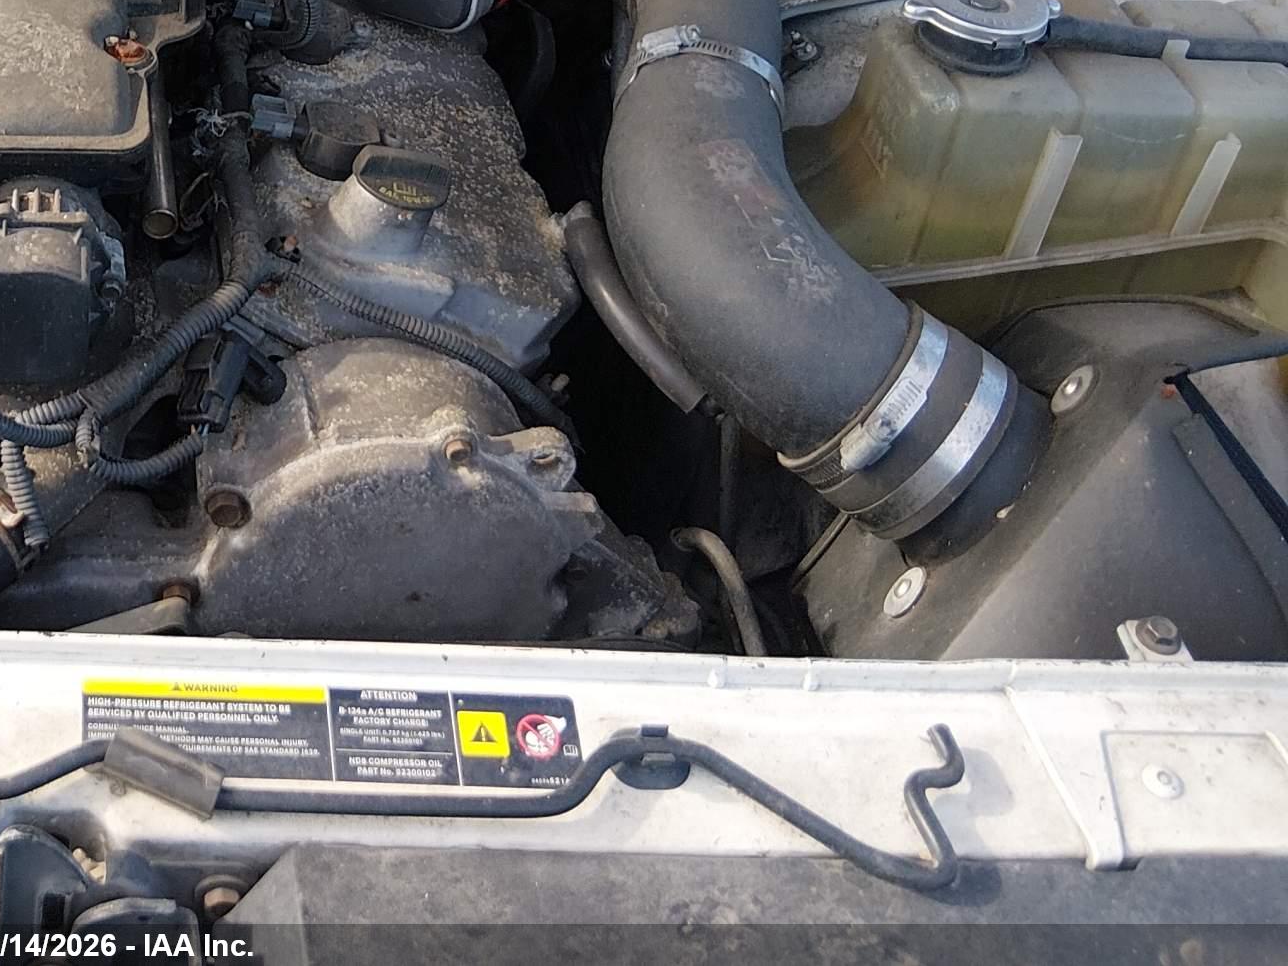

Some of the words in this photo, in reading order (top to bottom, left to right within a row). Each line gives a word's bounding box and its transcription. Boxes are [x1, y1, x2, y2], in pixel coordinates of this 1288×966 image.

[184, 683, 239, 694] WARNING
[360, 689, 418, 701] ATTENTION
[87, 696, 161, 709] HIGH-PRESSURE
[163, 700, 225, 712] REFRIGERANT
[227, 703, 263, 713] SYSTEM
[264, 704, 277, 713] TO
[278, 704, 291, 714] BE
[87, 708, 133, 718] SERVICED
[134, 709, 147, 718] BY
[148, 710, 195, 721] QUALIFIED
[197, 712, 252, 722] PERSONNEL
[253, 713, 280, 724] ONLY.
[367, 707, 385, 716] A/C
[386, 708, 442, 718] REFRIGERANT
[353, 717, 391, 726] FACTORY
[155, 726, 190, 734] MANUAL.
[159, 734, 196, 743] METHODS
[197, 736, 214, 744] MAY
[215, 736, 240, 745] CAUSE
[241, 737, 280, 746] PERSONAL
[280, 739, 309, 747] INJURY.
[363, 736, 380, 744] PART
[232, 745, 243, 754] OF
[260, 747, 300, 756] STANDARD
[369, 756, 427, 768] COMPRESSOR
[427, 759, 442, 768] OIL
[357, 766, 378, 776] PART
[380, 768, 394, 776] No.
